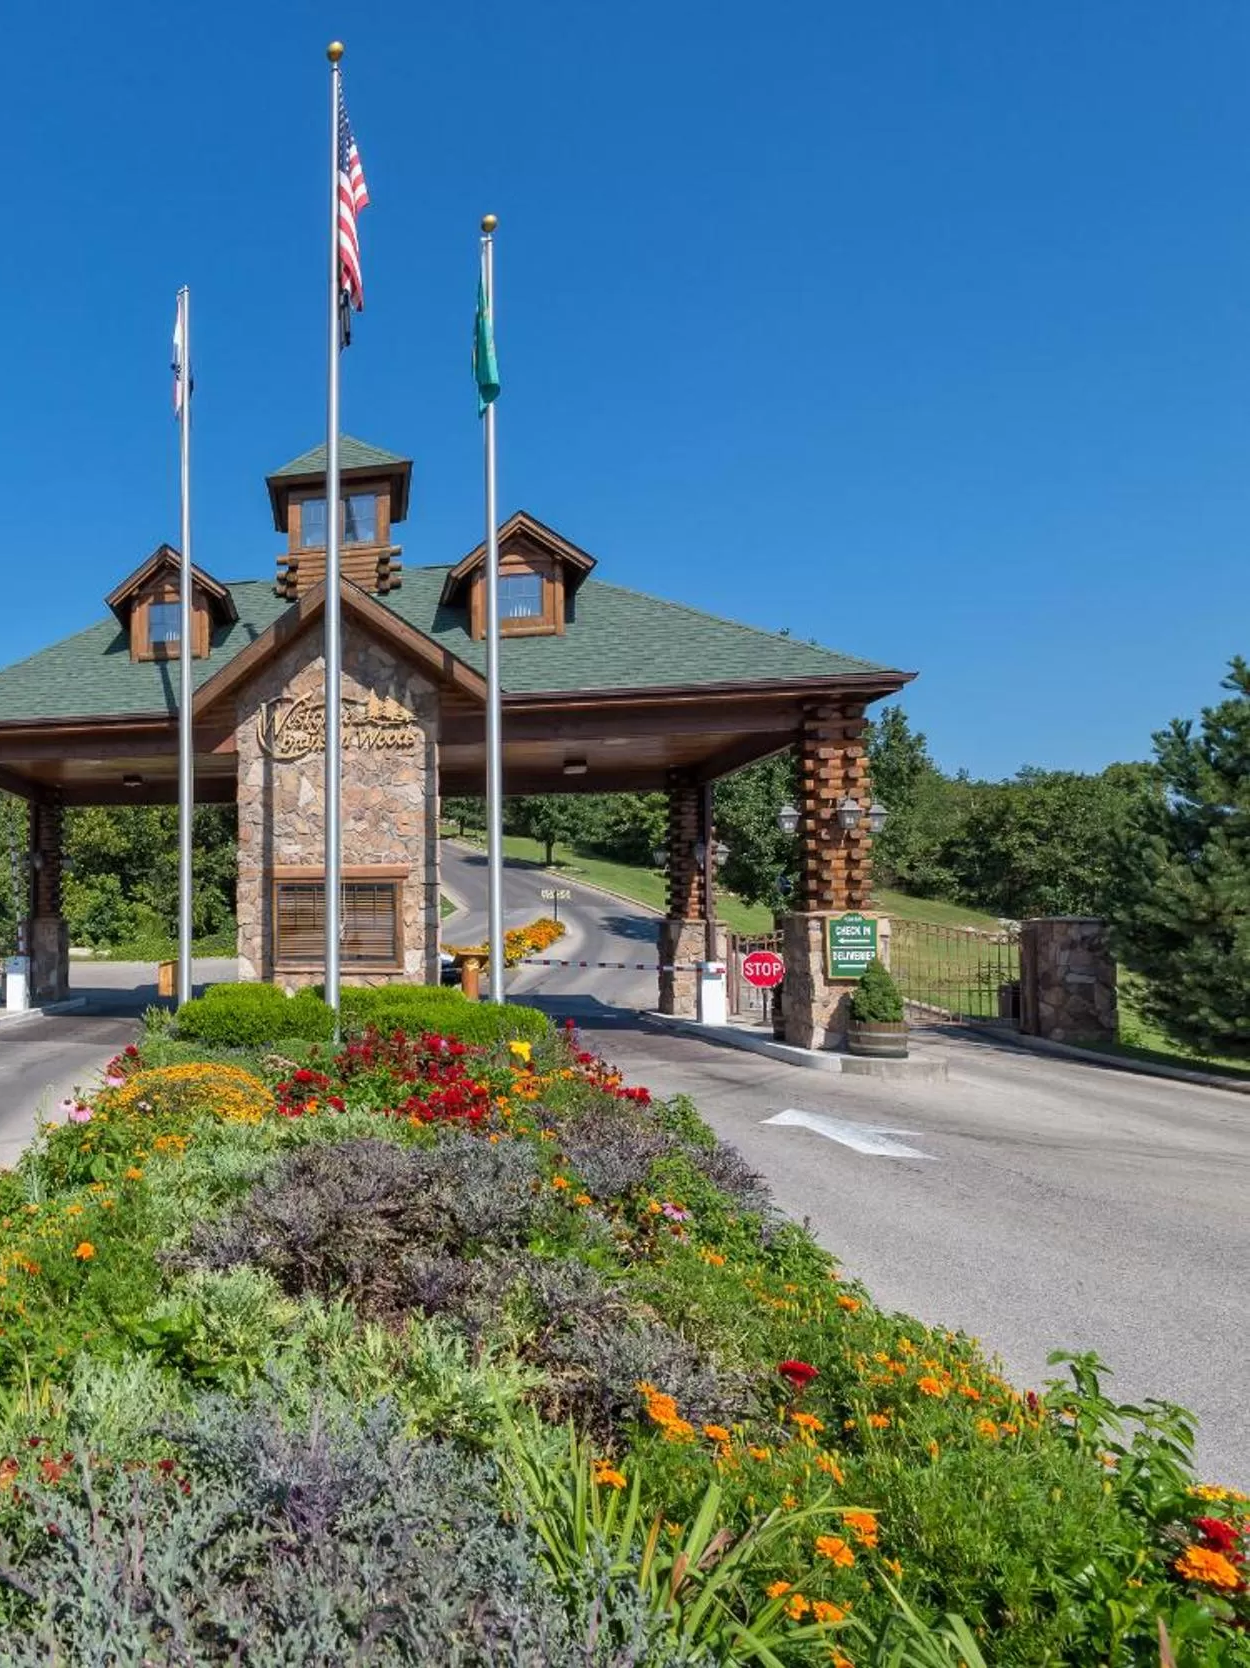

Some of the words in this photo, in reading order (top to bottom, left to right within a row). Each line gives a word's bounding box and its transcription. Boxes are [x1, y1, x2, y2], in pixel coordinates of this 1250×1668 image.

[358, 729, 416, 748] Woods
[835, 926, 862, 936] CHECK
[863, 926, 871, 936] IN
[745, 962, 781, 976] STOP
